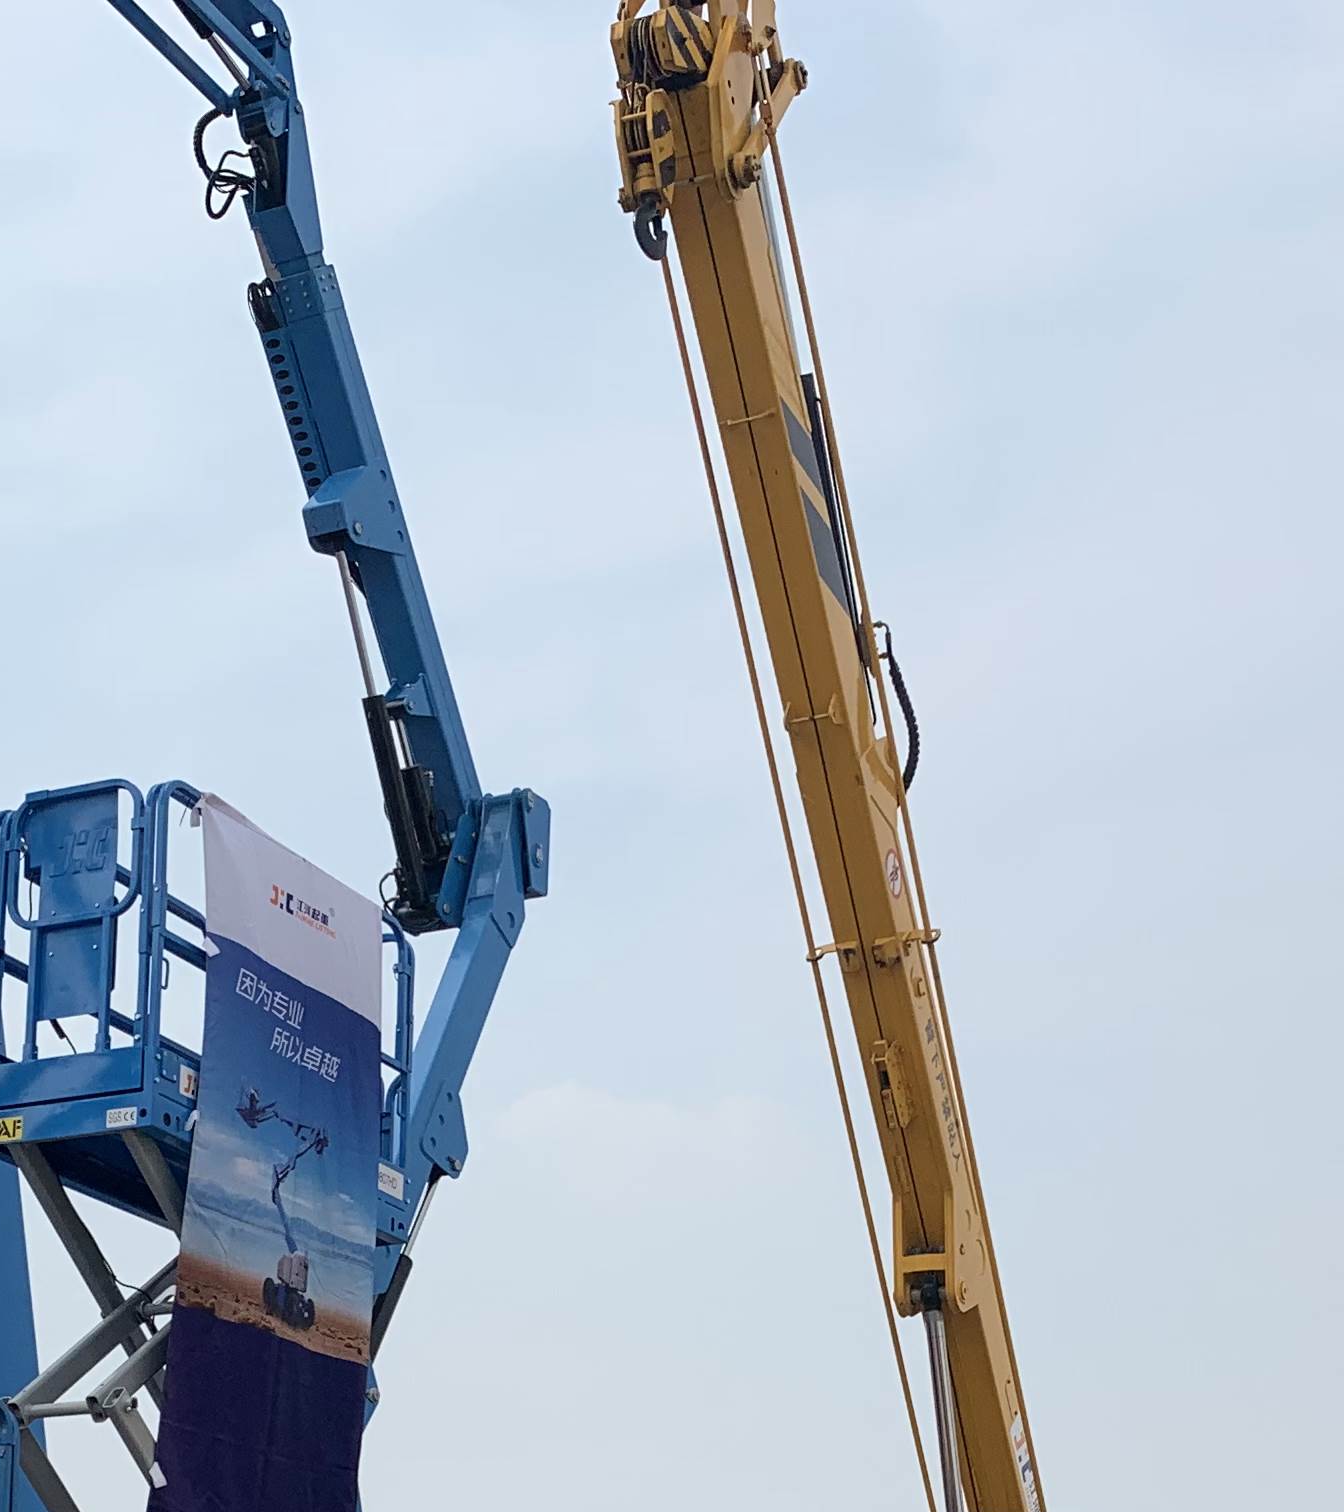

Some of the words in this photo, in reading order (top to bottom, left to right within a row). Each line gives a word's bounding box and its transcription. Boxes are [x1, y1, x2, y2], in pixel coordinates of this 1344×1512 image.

[236, 967, 305, 1030] 因为专业
[270, 1027, 341, 1083] 所以卓越
